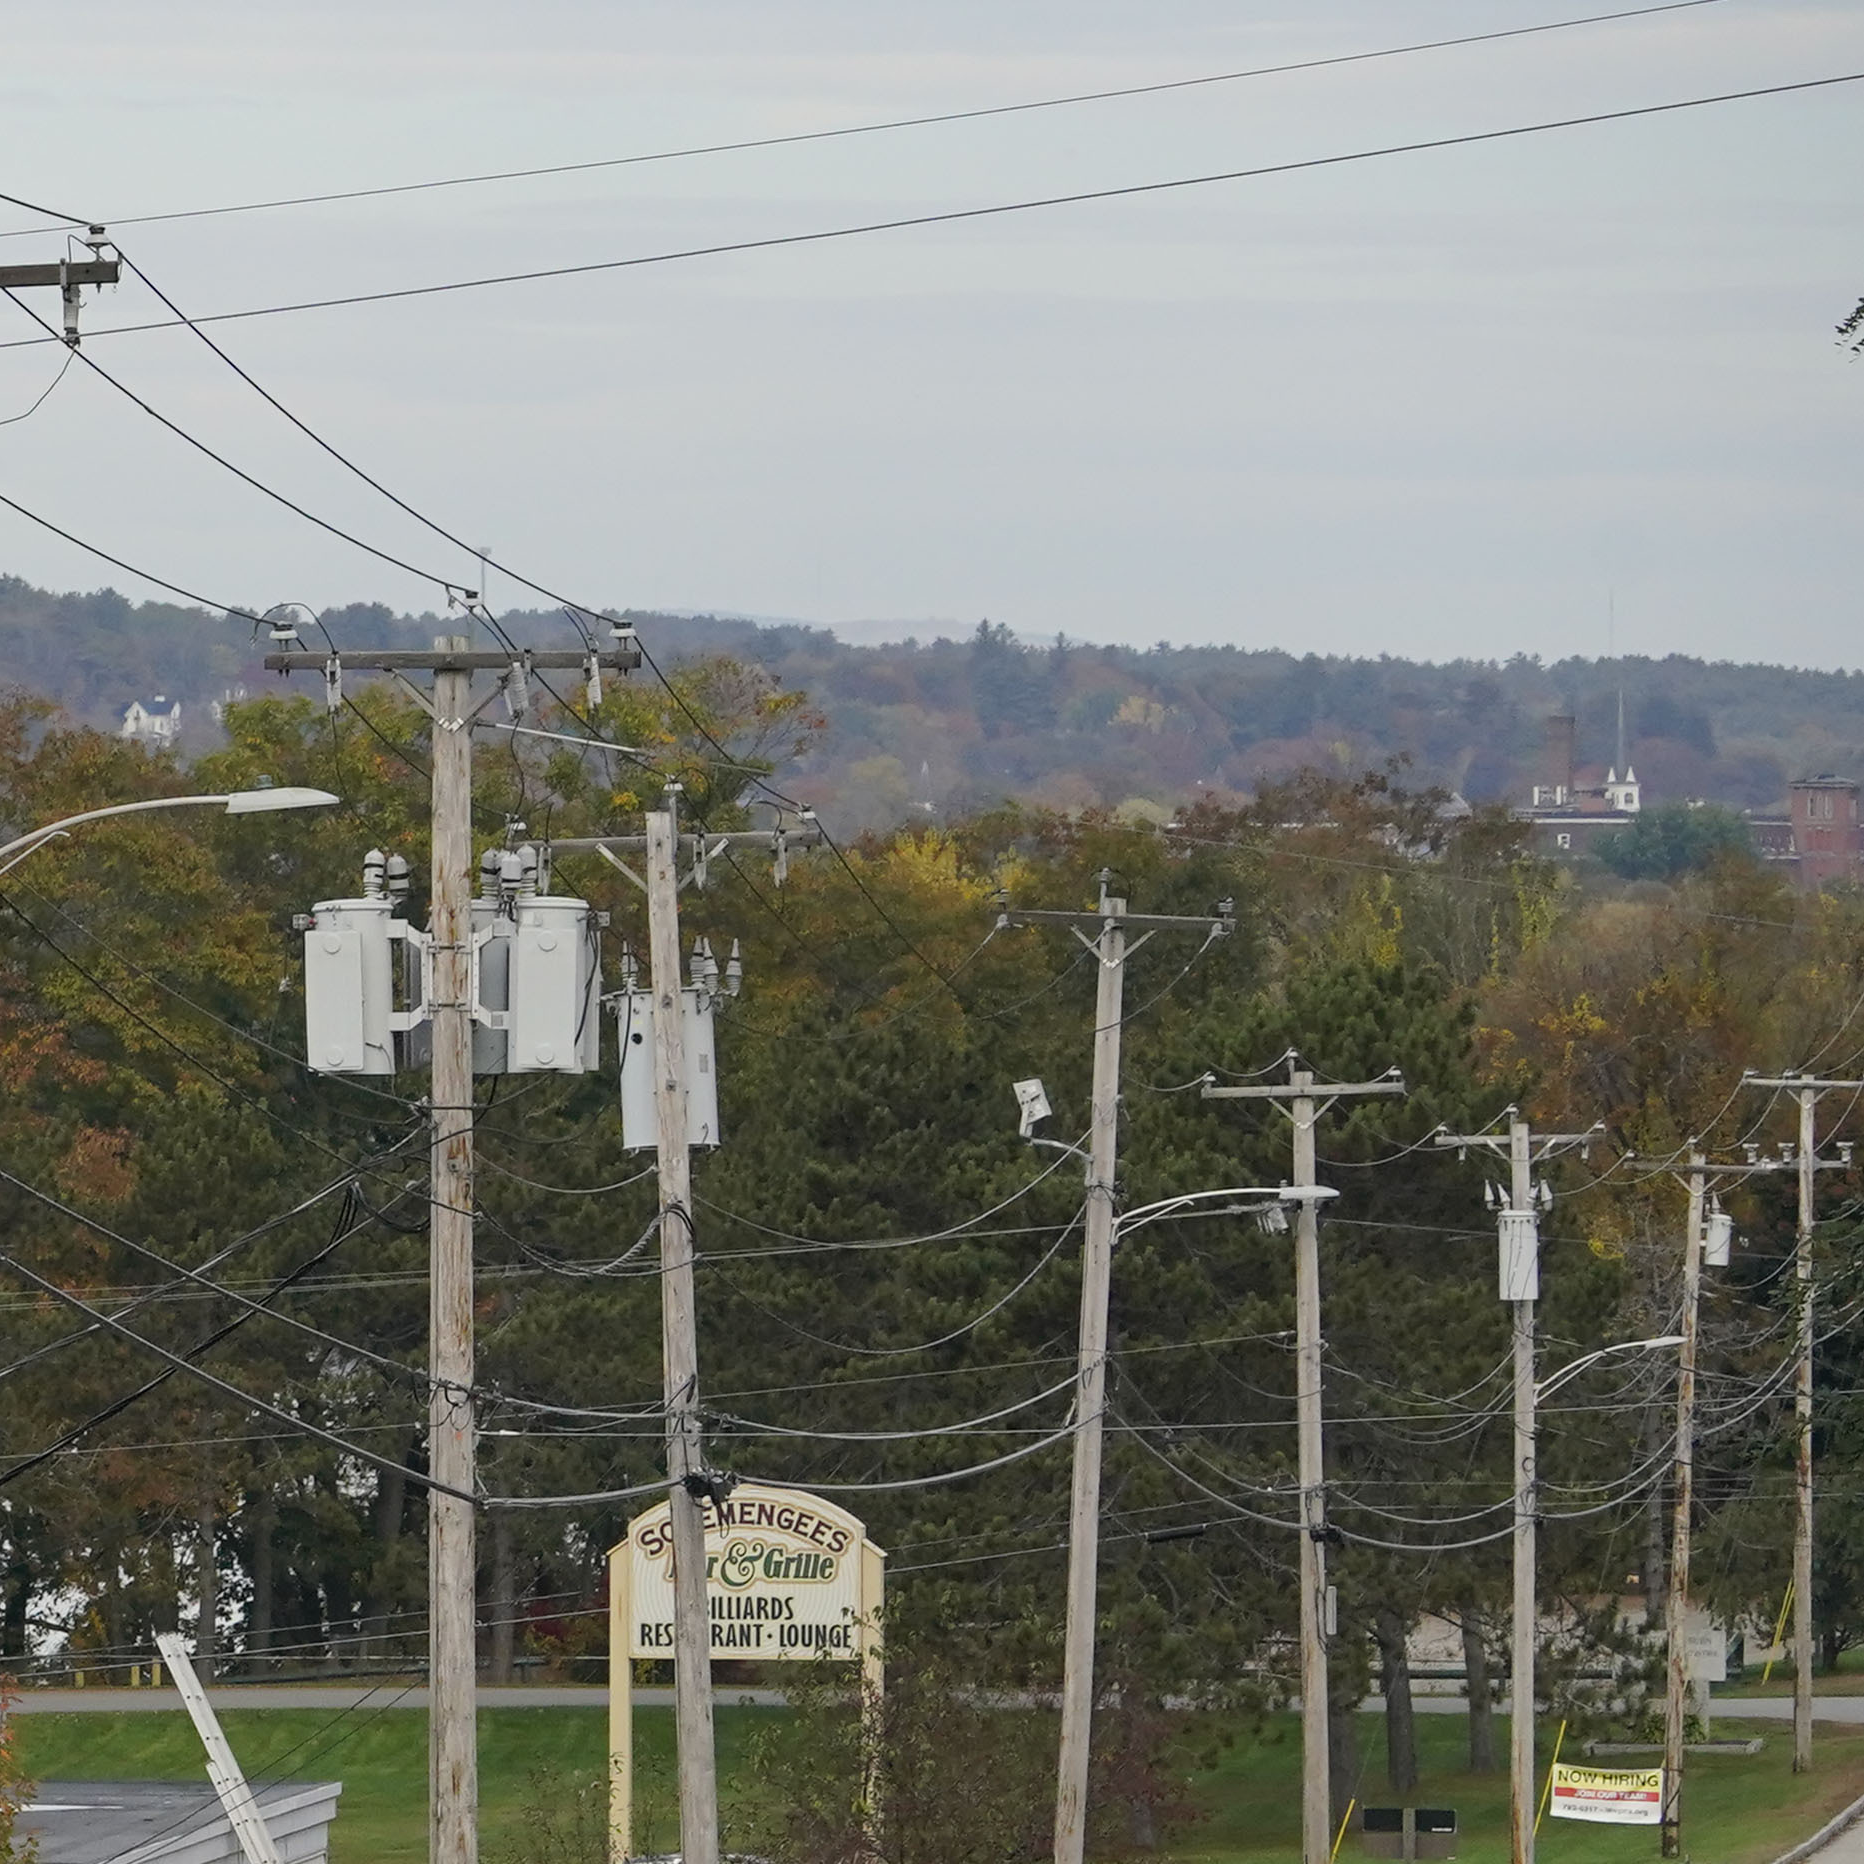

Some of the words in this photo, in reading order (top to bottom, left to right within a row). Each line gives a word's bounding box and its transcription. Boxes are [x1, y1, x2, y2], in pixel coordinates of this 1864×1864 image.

[640, 1502, 849, 1556] SCEMENGEES
[763, 1548, 834, 1580] Grille
[706, 1596, 794, 1621] ILLIARDS
[639, 1622, 764, 1648] RESRANT
[779, 1623, 852, 1649] LOUNGE
[1558, 1770, 1598, 1783] NOW
[1602, 1773, 1659, 1787] HIRING
